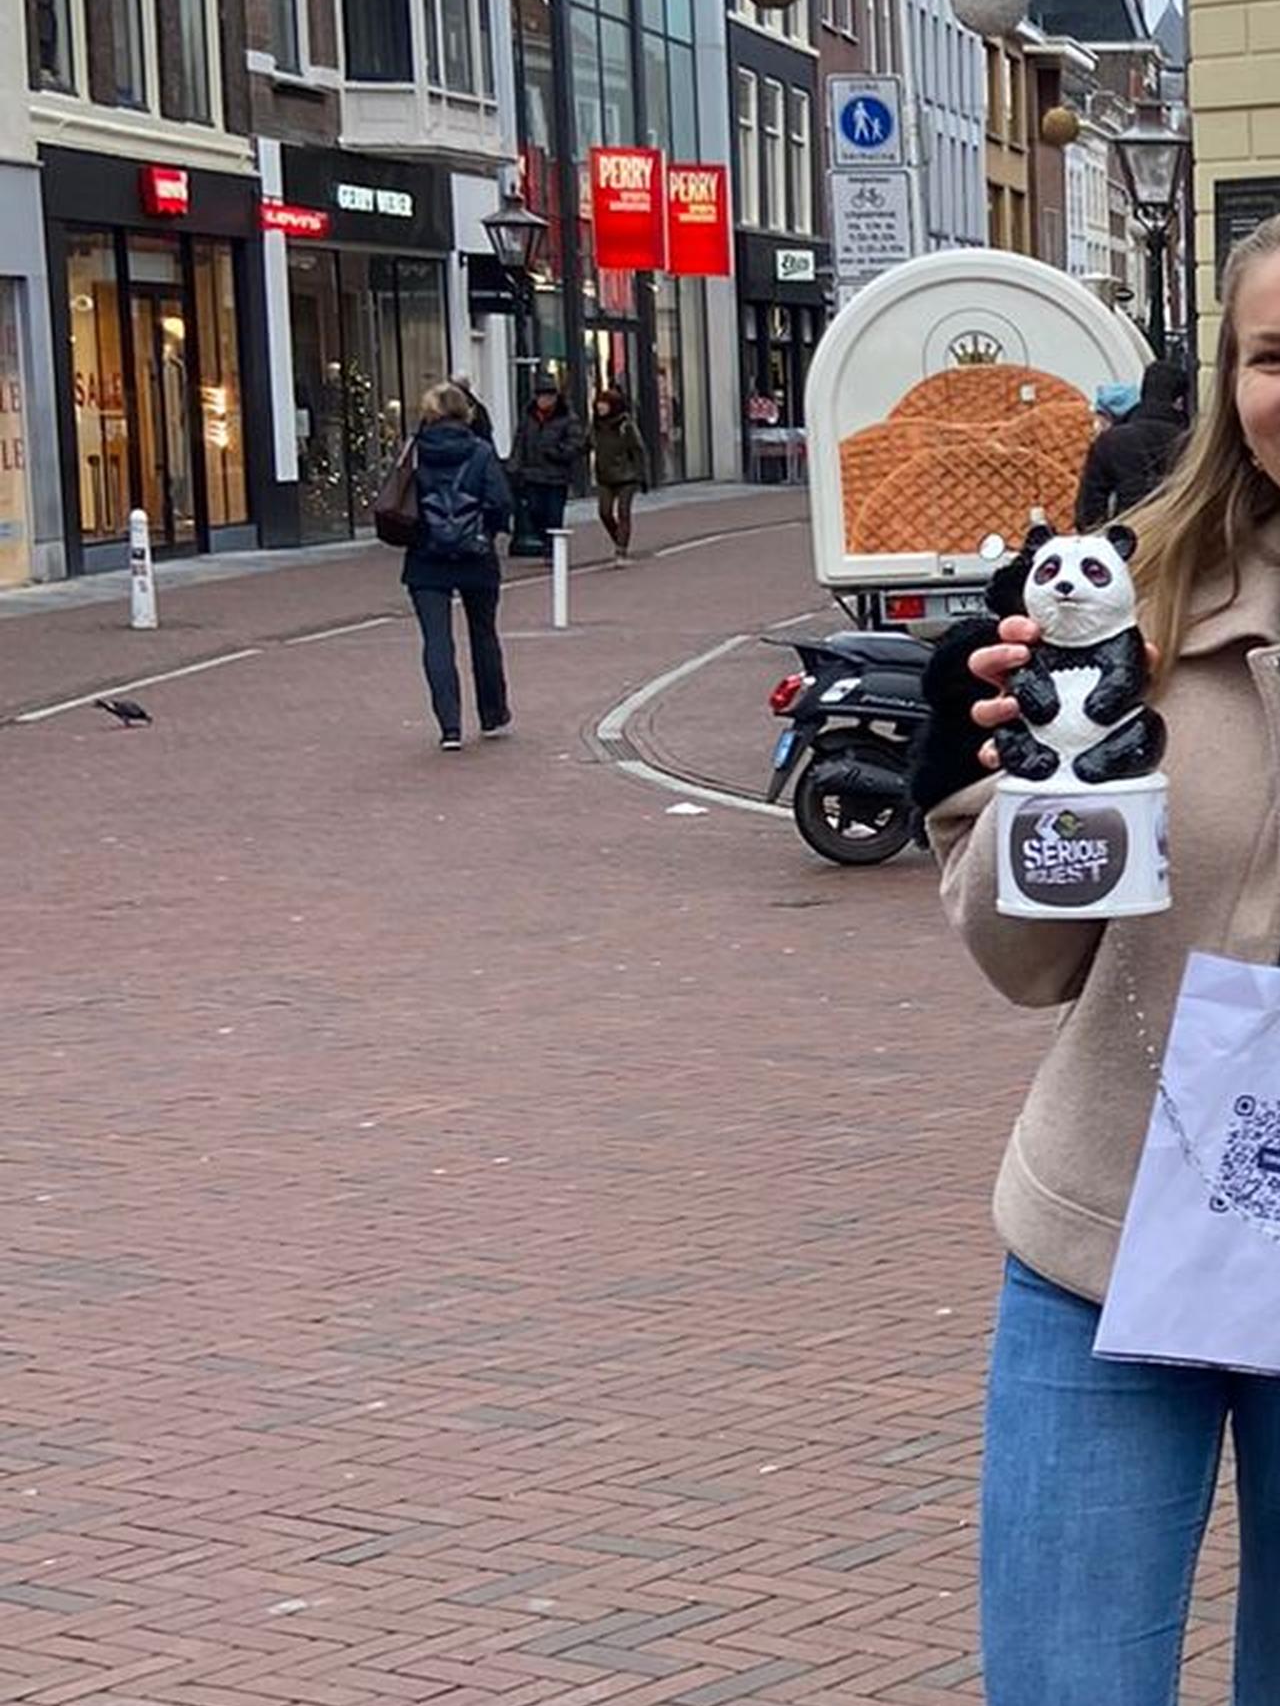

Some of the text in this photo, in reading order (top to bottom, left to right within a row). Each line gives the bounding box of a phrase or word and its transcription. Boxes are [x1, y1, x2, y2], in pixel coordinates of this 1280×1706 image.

[600, 155, 653, 190] PERRY
[670, 171, 718, 205] PERRY
[1023, 839, 1109, 869] SERIOUS
